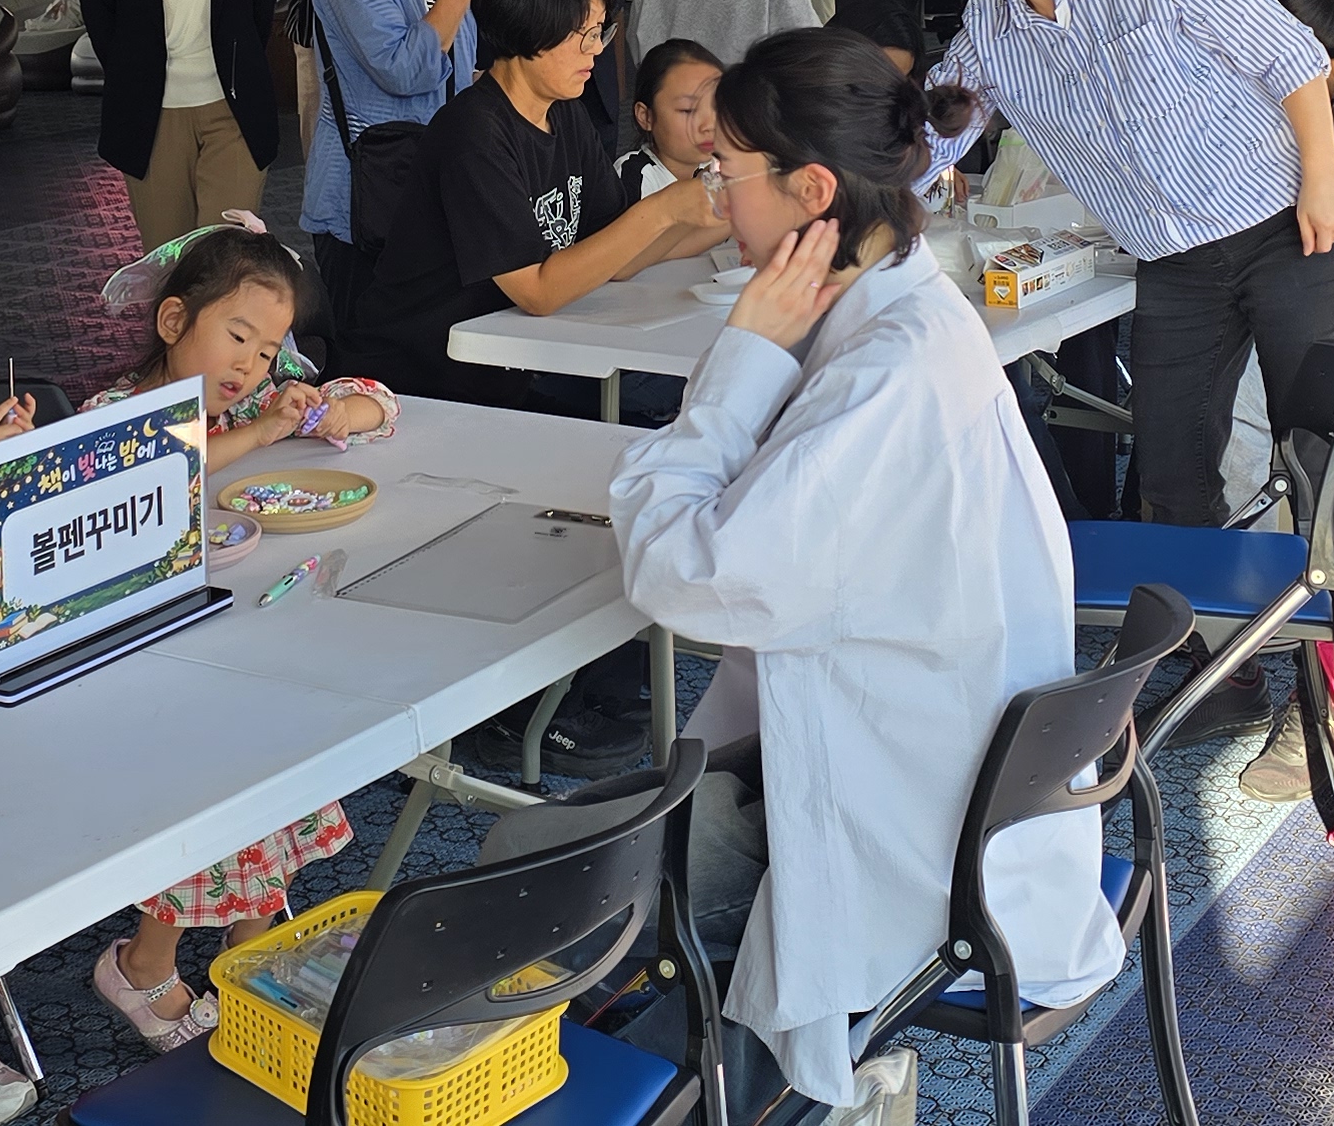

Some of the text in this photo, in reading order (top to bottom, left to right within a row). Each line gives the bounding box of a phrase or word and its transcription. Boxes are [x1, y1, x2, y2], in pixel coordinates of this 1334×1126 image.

[37, 437, 157, 495] 책이 빛나는 밤에
[30, 485, 165, 576] 볼펜꾸미기
[548, 730, 576, 750] Jeep
